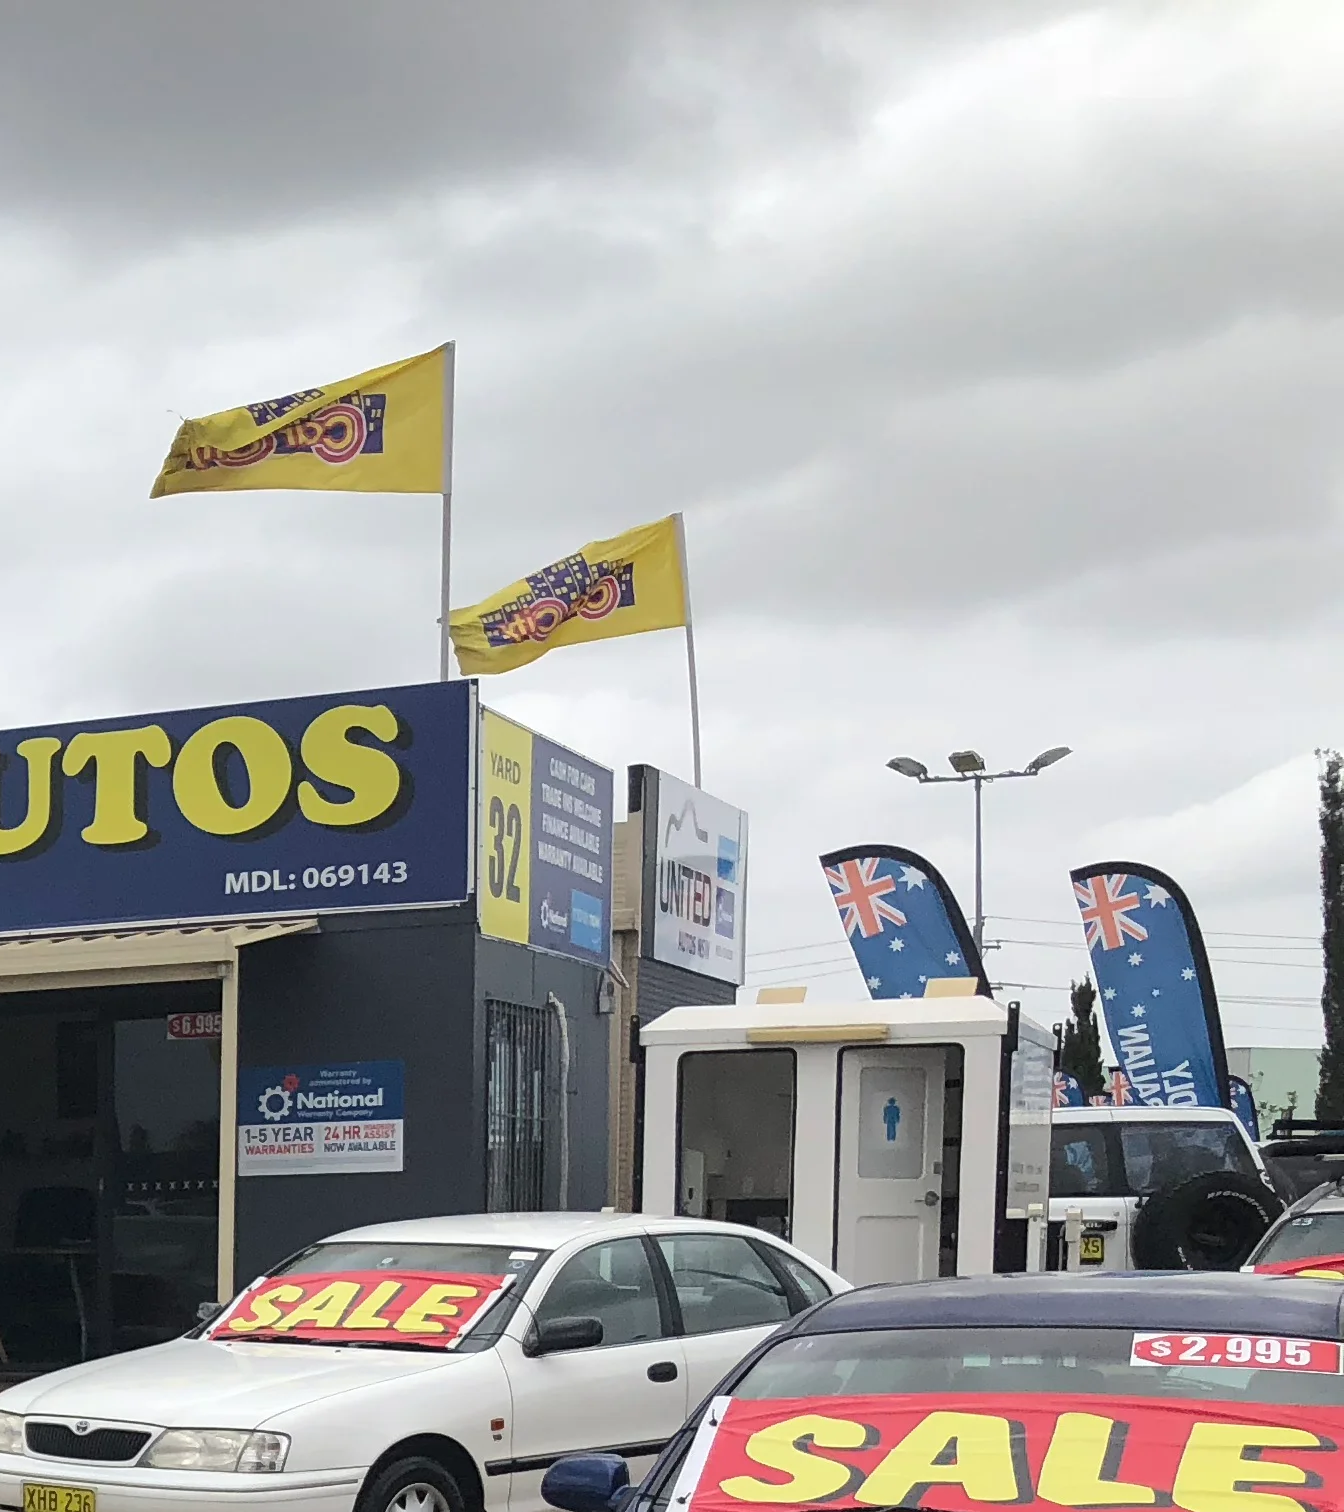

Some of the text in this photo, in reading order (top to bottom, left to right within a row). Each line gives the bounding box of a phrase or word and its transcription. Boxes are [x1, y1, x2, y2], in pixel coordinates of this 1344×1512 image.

[490, 750, 520, 785] YARD
[489, 795, 521, 903] 32
[224, 861, 409, 895] MDL: 069143
[659, 857, 712, 927] UNITED
[172, 1014, 222, 1035] $6,995
[362, 1078, 372, 1086] by
[297, 1087, 384, 1110] National
[297, 1109, 374, 1120] Warranty Company
[245, 1126, 314, 1144] 1-5 YEAR
[324, 1125, 361, 1141] 24 HR
[363, 1129, 396, 1139] ASSIST
[245, 1143, 315, 1156] WARRANTIES
[323, 1140, 396, 1153] NOW AVAILABLE
[228, 1280, 479, 1335] SALE
[1150, 1336, 1311, 1366] $2,995
